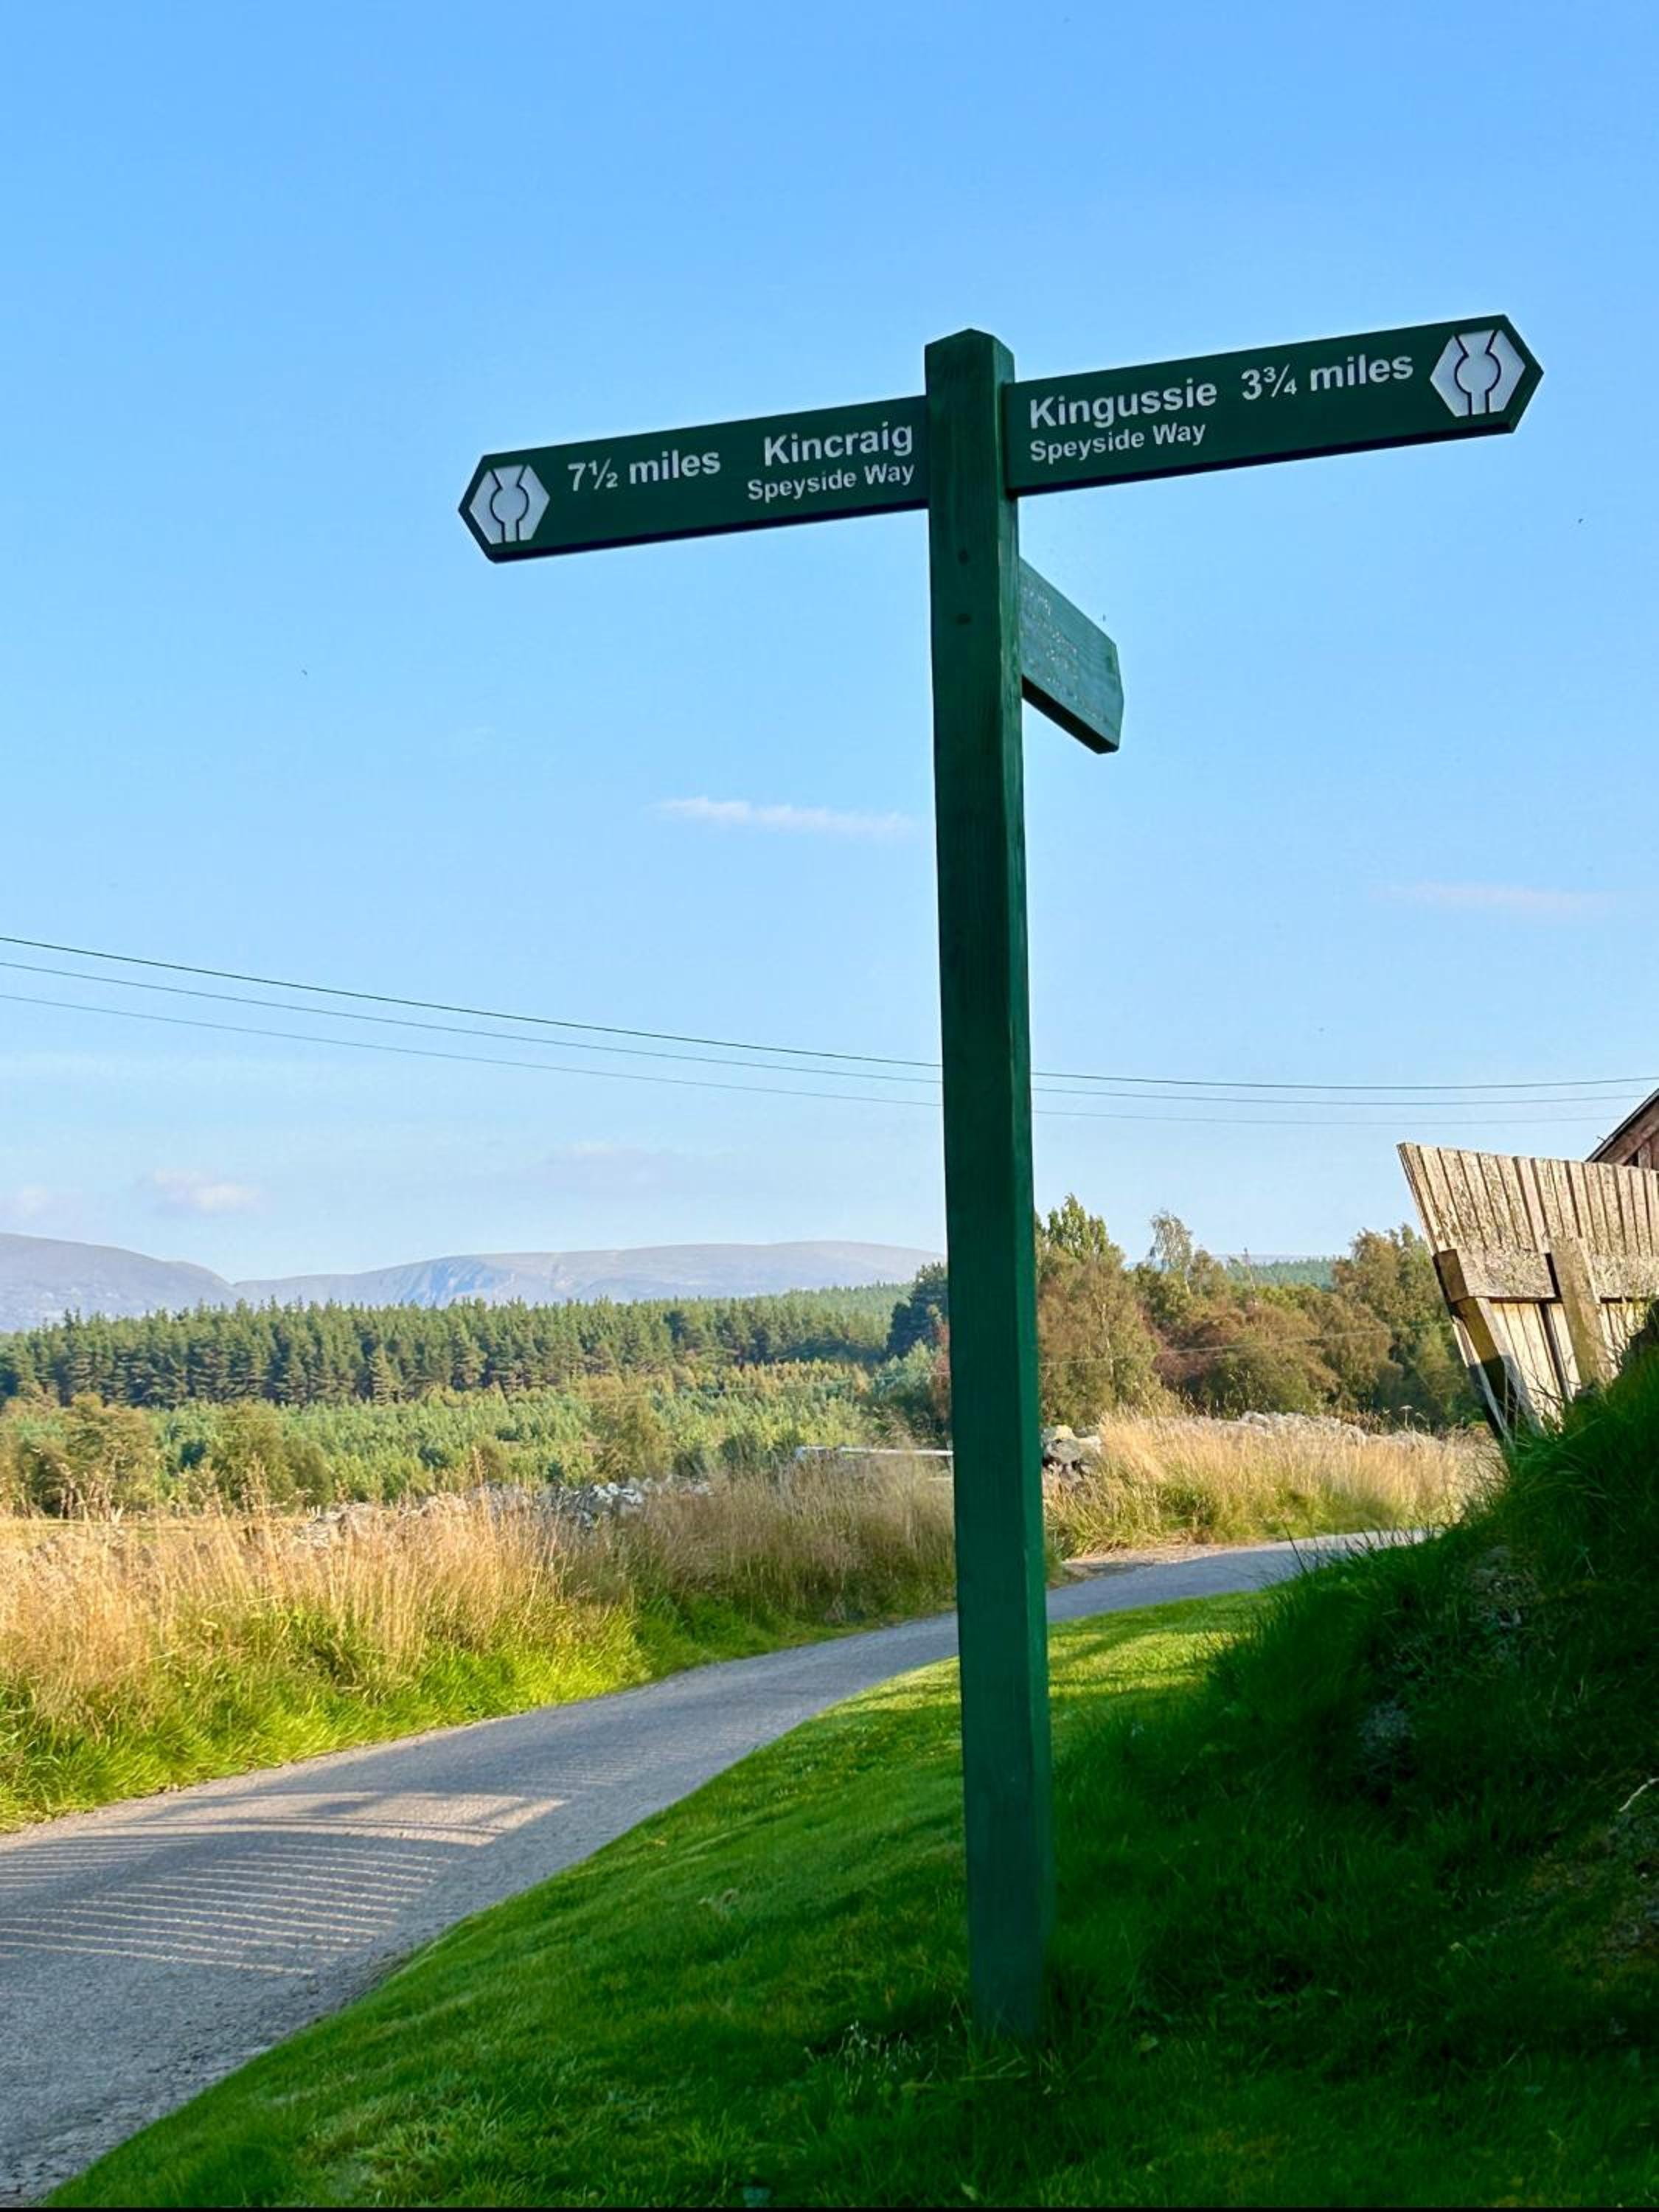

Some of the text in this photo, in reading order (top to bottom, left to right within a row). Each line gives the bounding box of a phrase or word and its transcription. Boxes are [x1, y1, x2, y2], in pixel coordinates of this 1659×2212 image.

[1030, 378, 1217, 429] Kingussie
[1310, 355, 1413, 392] miles
[629, 451, 720, 484] miles
[765, 421, 912, 467] Kincraig
[1030, 422, 1206, 465] Speyside Way
[748, 463, 914, 503] Speyside Way
